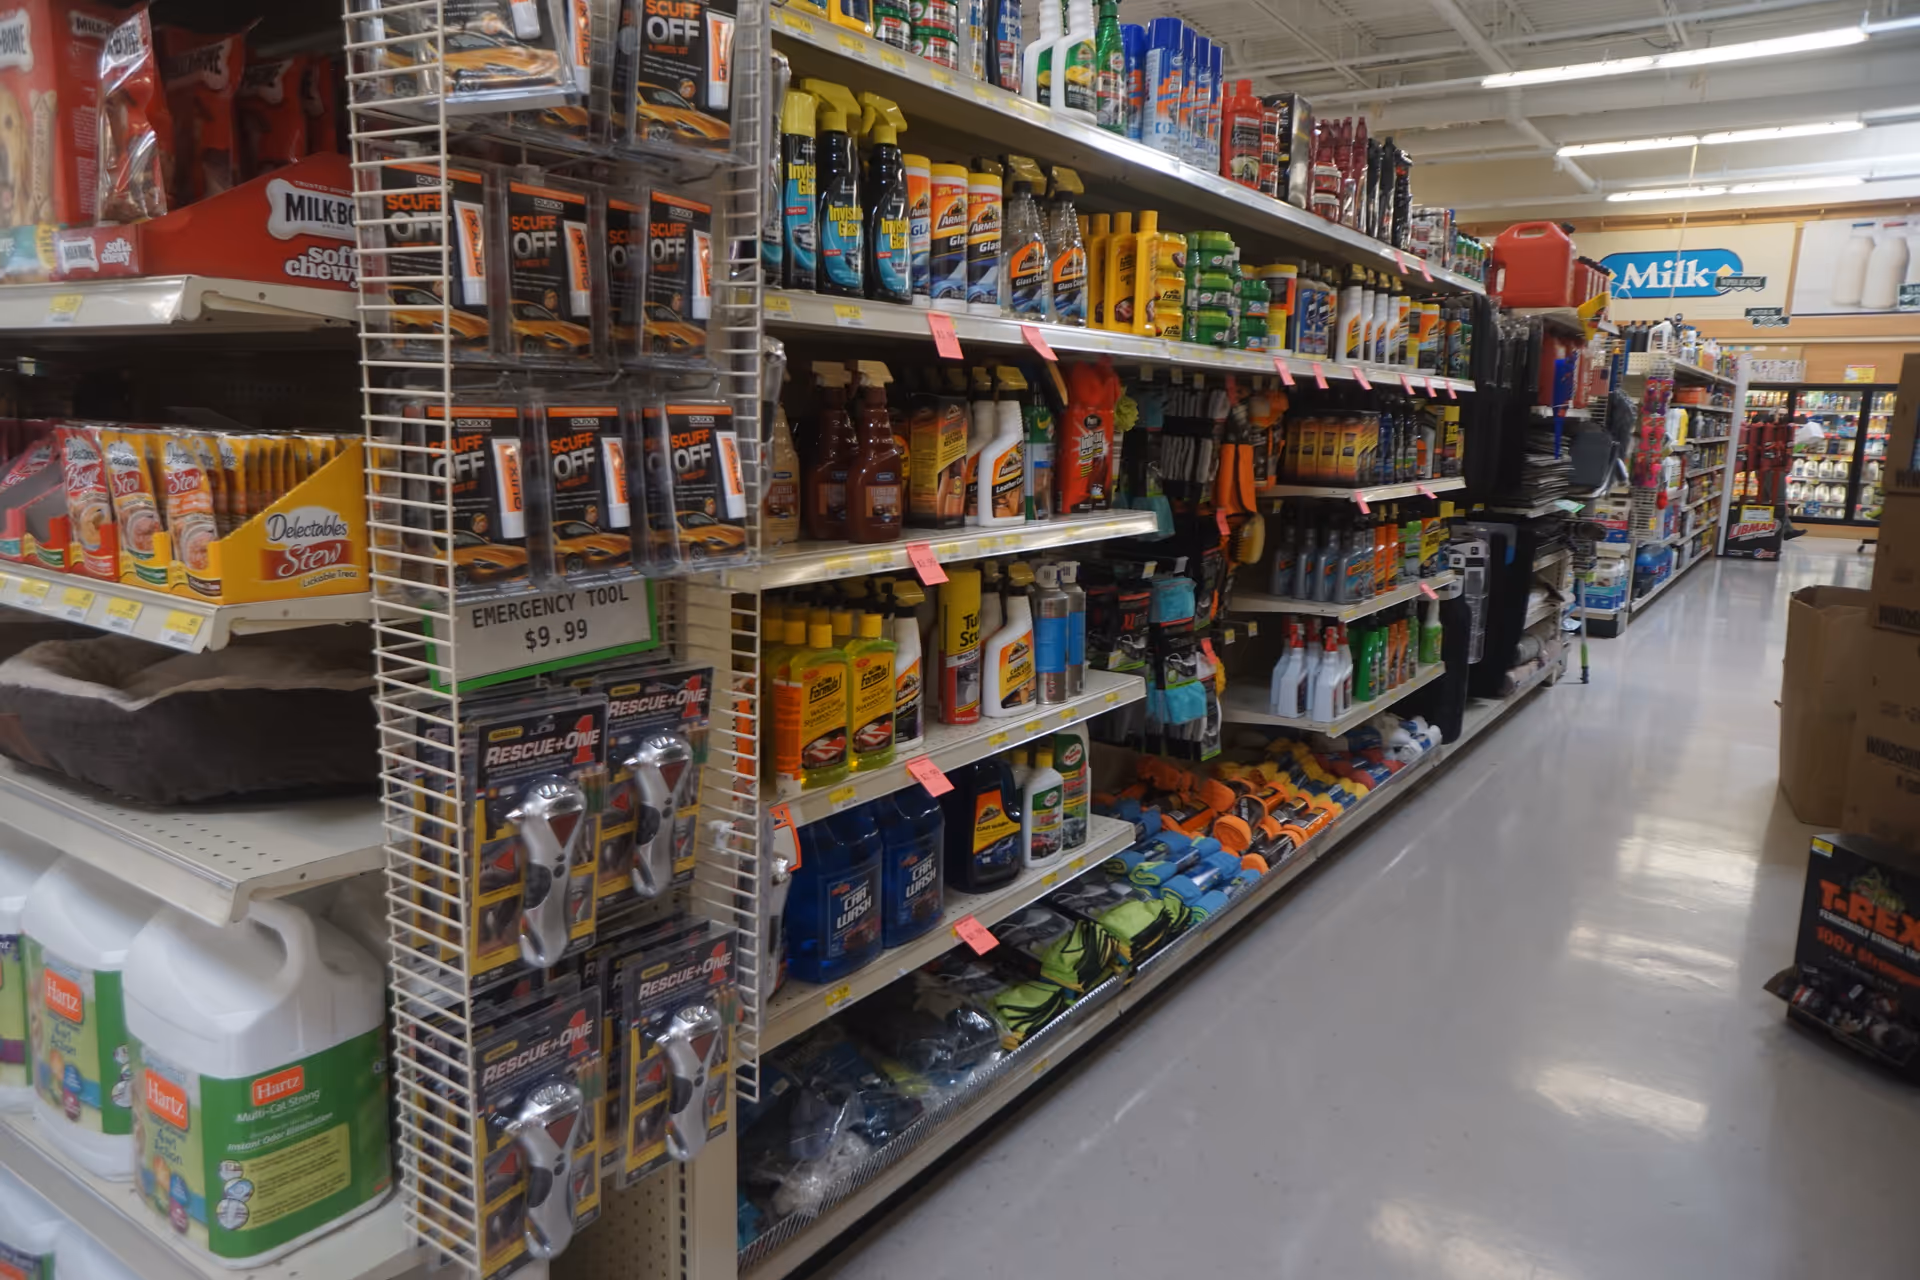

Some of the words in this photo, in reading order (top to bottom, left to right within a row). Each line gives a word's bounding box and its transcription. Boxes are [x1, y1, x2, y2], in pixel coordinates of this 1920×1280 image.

[647, 16, 700, 45] OFF
[285, 192, 357, 228] MILK-BO
[386, 193, 443, 211] SCUFF
[512, 215, 557, 231] SCUFF
[650, 222, 687, 238] SCUFF
[513, 231, 557, 259] OFF
[650, 237, 686, 263] OFF
[1622, 259, 1710, 290] Milk
[459, 420, 491, 428] QUIXX
[550, 432, 594, 454] SCUFF
[671, 429, 710, 449] SCUFF
[554, 446, 596, 481] OFF
[673, 442, 712, 474] OFF
[996, 478, 1017, 493] Leather
[267, 513, 348, 541] Delectables
[1728, 521, 1777, 540] LIBMAN
[278, 543, 342, 577] Stew
[472, 593, 577, 629] EMERGENCY
[586, 584, 630, 608] TOOL
[525, 618, 588, 653] $9.99
[809, 676, 839, 701] Formula
[861, 665, 887, 687] Formula
[607, 687, 708, 717] RESCUE+ONE
[484, 728, 601, 768] RESCUE+ONE
[906, 866, 937, 898] WASH
[837, 895, 872, 929] WASH
[844, 886, 867, 911] CAR
[639, 951, 733, 1001] RESCUE+ONE
[47, 977, 79, 1013] Hartz
[482, 1018, 595, 1087] RESCUE+ONE
[148, 1079, 185, 1119] Hartz
[256, 1075, 300, 1100] Hartz
[236, 1100, 287, 1124] Multi-Cat
[288, 1088, 321, 1107] Strong
[227, 1138, 261, 1153] Instant
